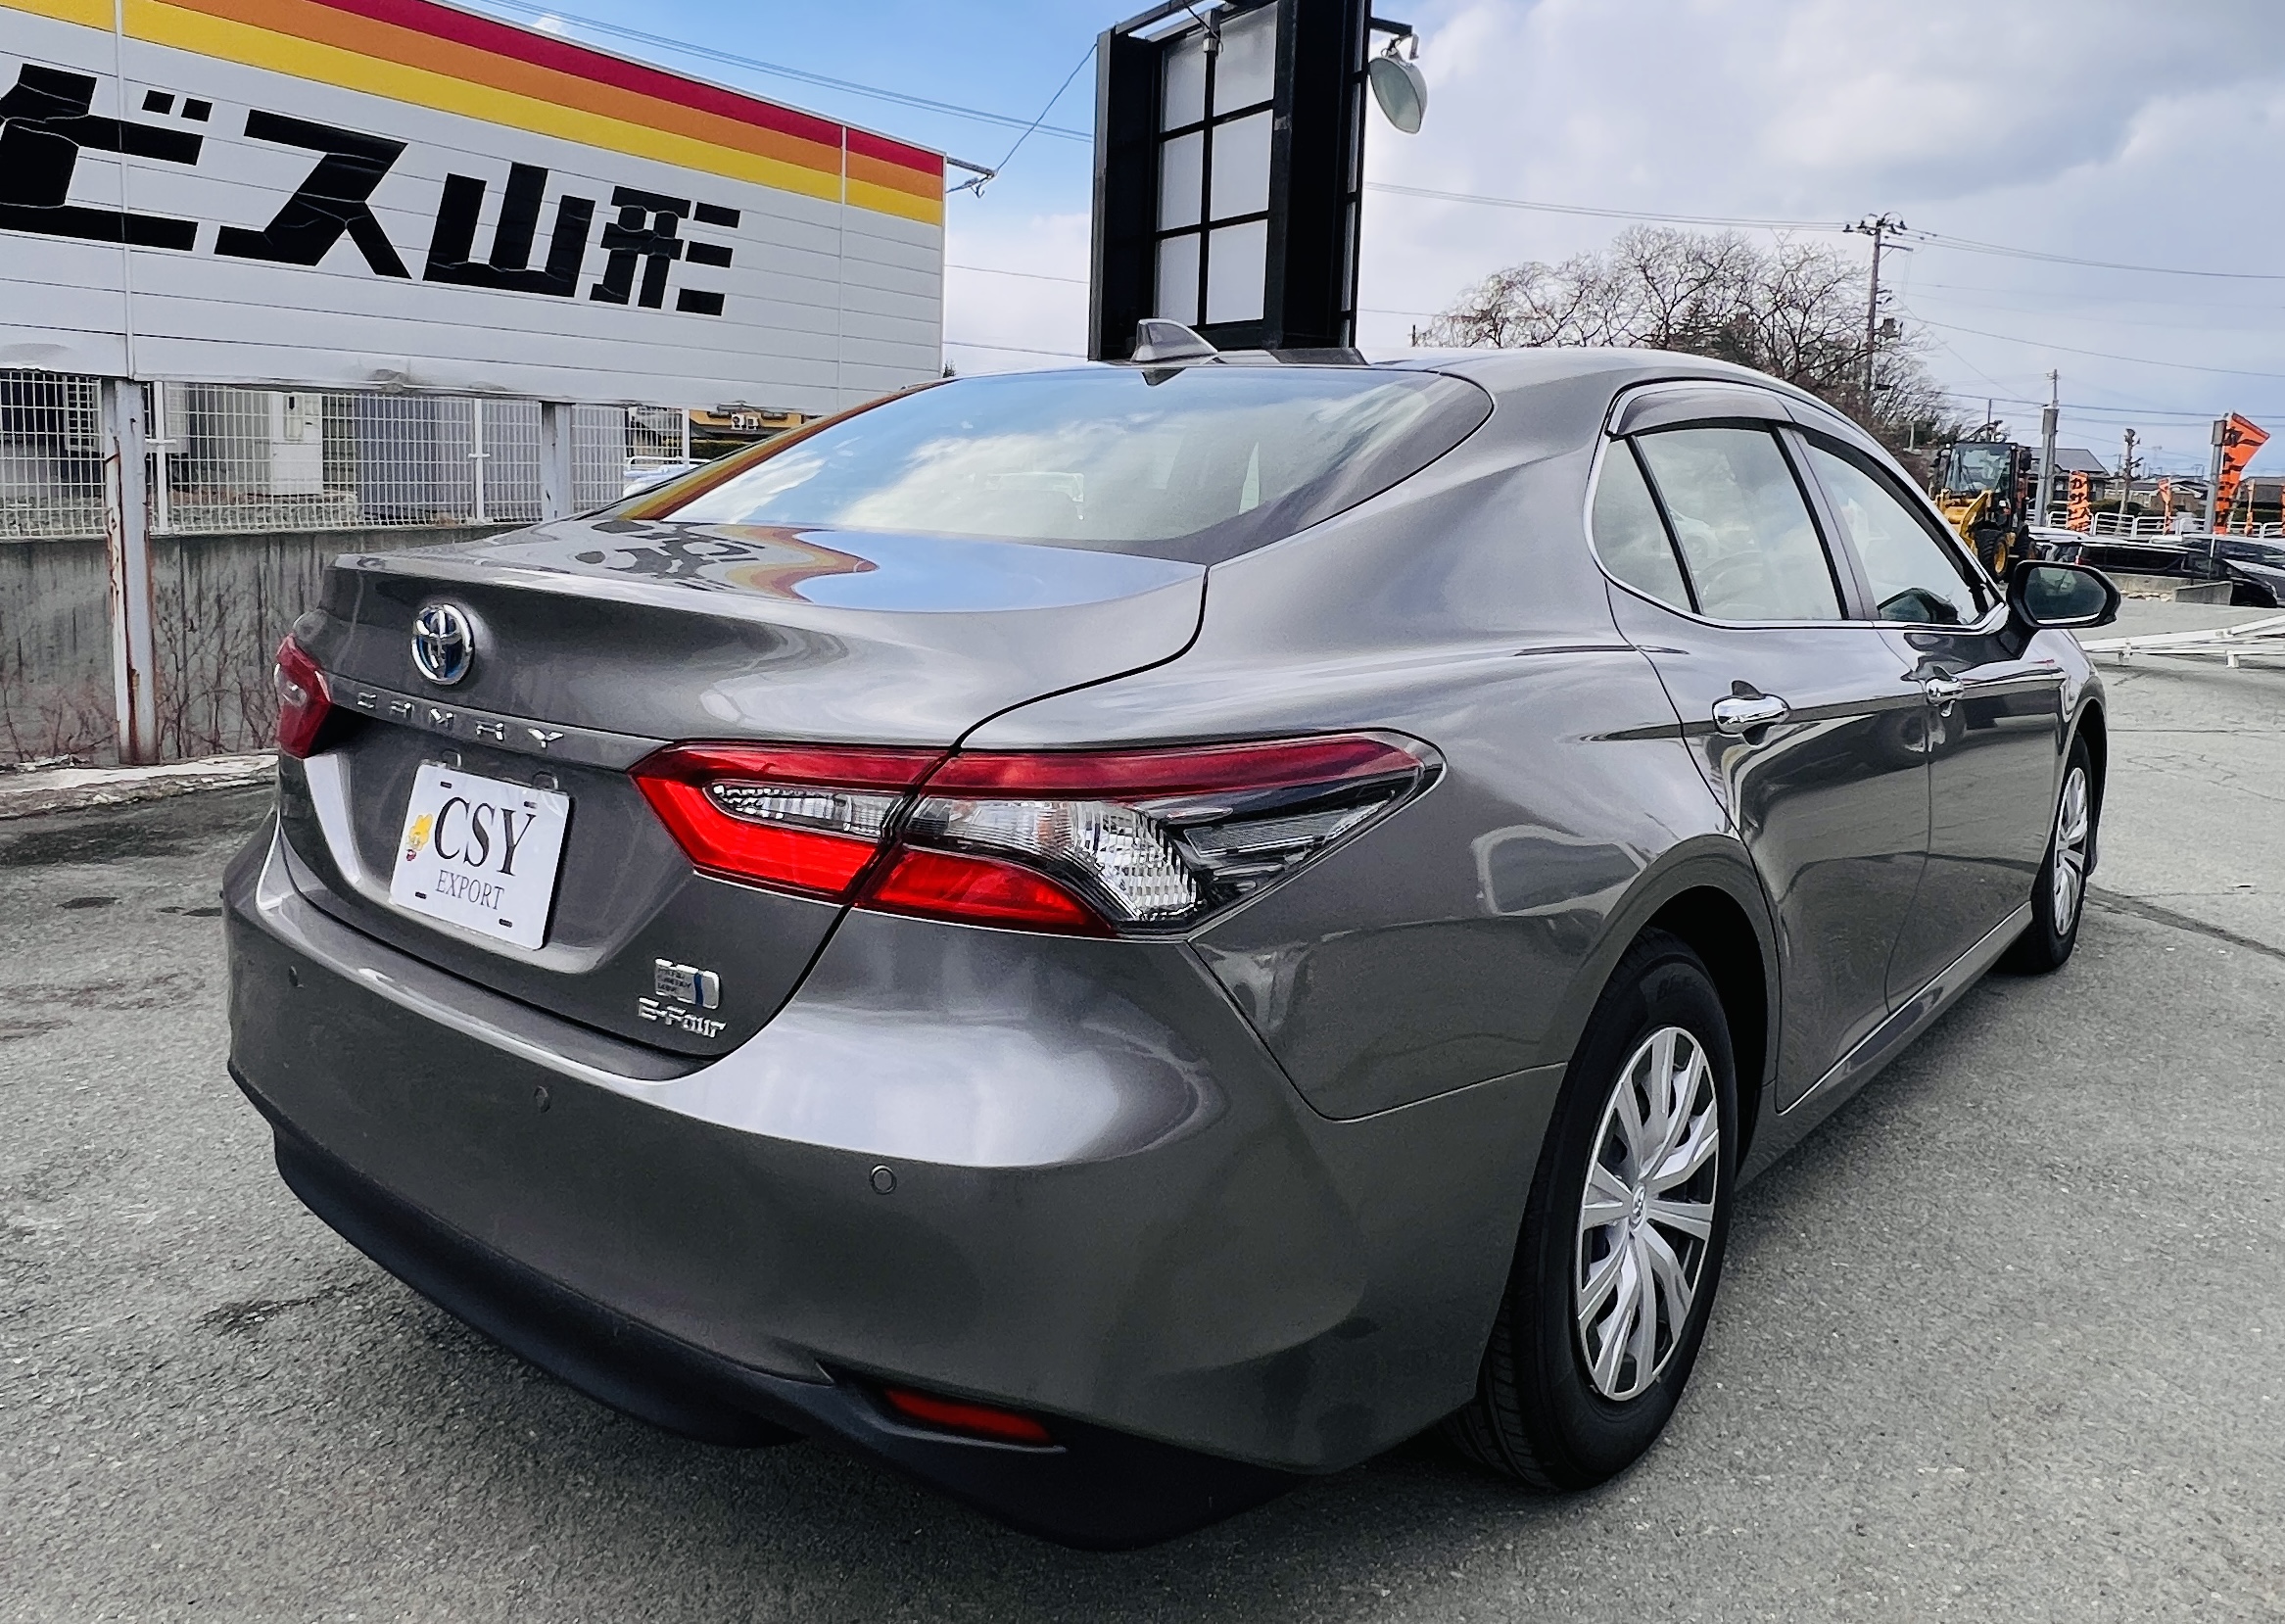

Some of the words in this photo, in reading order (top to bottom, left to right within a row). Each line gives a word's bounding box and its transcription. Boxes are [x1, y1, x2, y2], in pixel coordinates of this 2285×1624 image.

[357, 692, 565, 749] CAMRY
[434, 796, 537, 877] CSY
[434, 869, 505, 911] EXPORT
